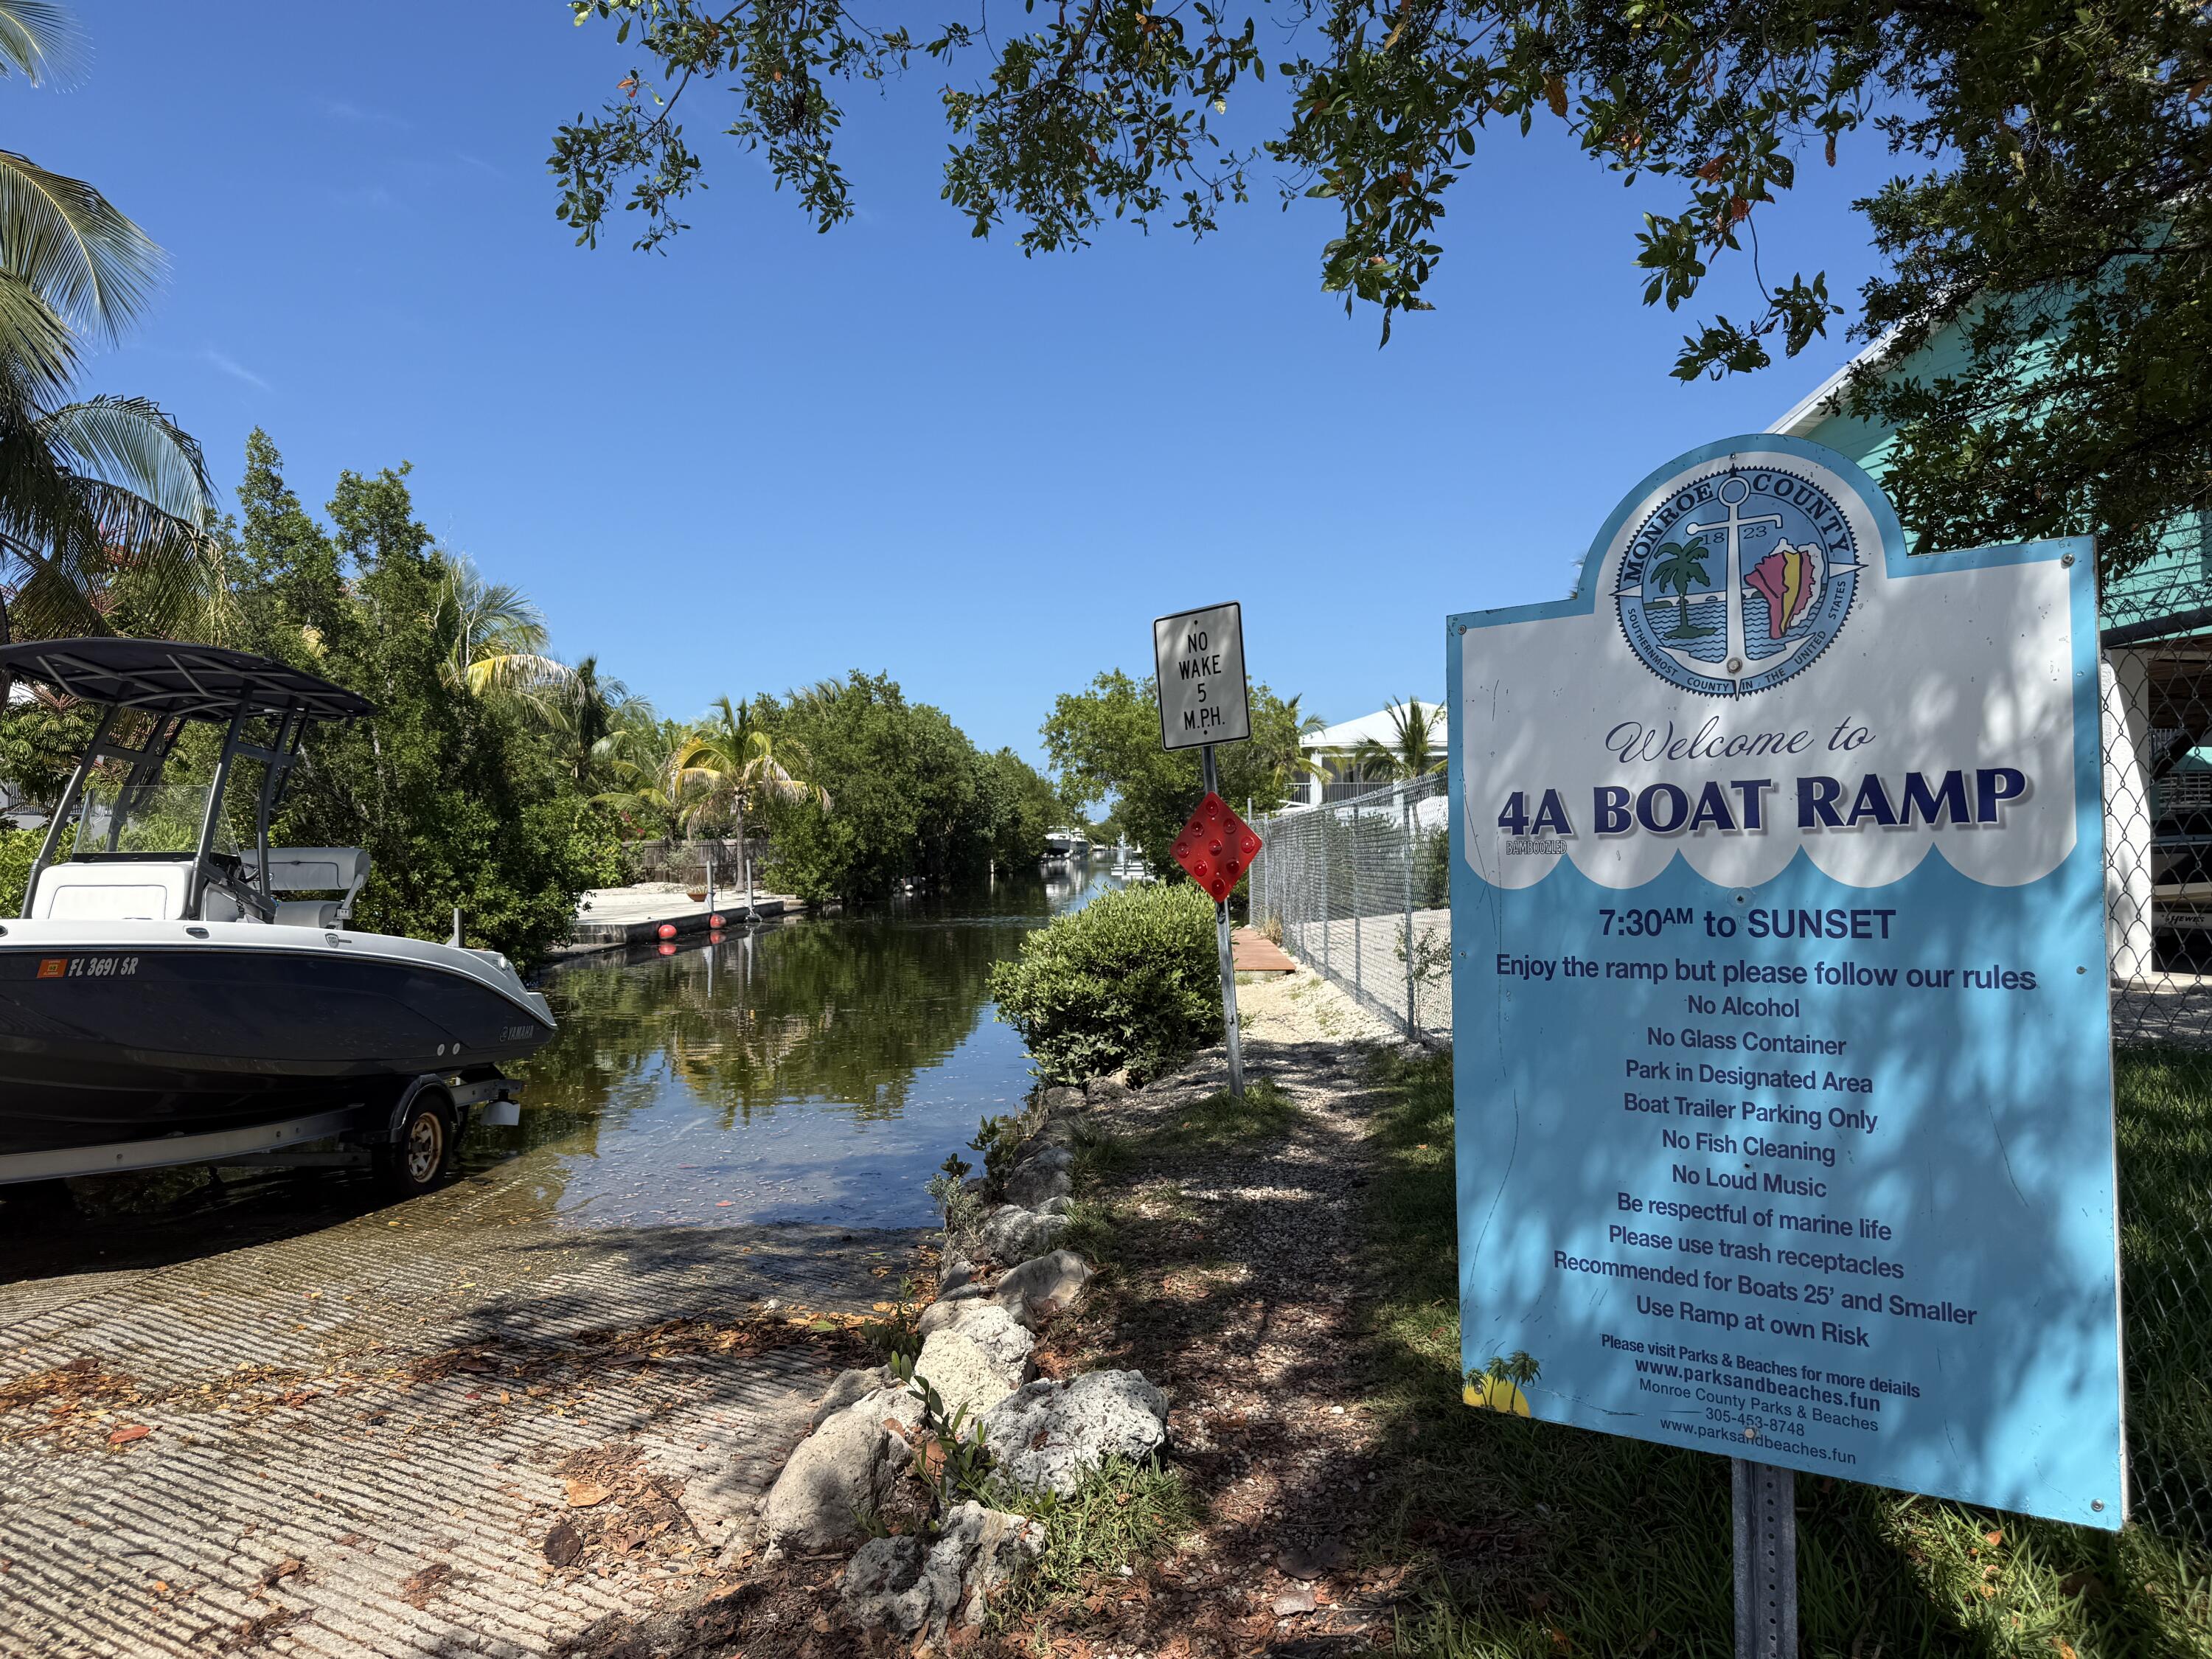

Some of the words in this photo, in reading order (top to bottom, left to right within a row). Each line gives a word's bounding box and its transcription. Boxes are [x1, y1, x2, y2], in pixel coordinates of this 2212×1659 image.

[1624, 483, 1713, 582] MONROE
[1753, 474, 1849, 553] COUNTY
[1703, 531, 1724, 545] 18
[1744, 526, 1767, 539] 23
[1188, 632, 1208, 653] NO
[1628, 608, 1677, 676] SOUTHERNMOST
[1687, 677, 1728, 692] COUNTY
[1742, 681, 1753, 690] IN
[1765, 668, 1786, 683] THE
[1795, 630, 1826, 665] UNITED
[1829, 581, 1846, 619] STATES
[1179, 655, 1221, 680] WAKE
[1197, 683, 1207, 703] 5
[1184, 706, 1225, 730] M.P.H.
[1605, 715, 1815, 765] Welcome
[1828, 716, 1876, 751] to
[1498, 789, 1572, 835] 4A
[1593, 779, 1773, 834] BOAT
[1797, 768, 2026, 828] RAMP
[1506, 840, 1567, 855] BAMBOOZLED
[1704, 911, 1736, 937] to
[1747, 909, 1896, 939] SUNSET
[69, 959, 85, 976] FL
[87, 958, 119, 976] 3691
[121, 957, 138, 975] SR
[1496, 954, 1557, 981] Enjoy
[1562, 956, 1600, 979] the
[1605, 961, 1667, 986] ramp
[1675, 959, 1716, 982] but
[1723, 960, 1807, 987] please
[1815, 961, 1901, 988] follow
[1907, 968, 1953, 990] our
[1963, 964, 2037, 991] rules
[1688, 995, 1715, 1015] No
[1722, 997, 1799, 1018] Alcohol
[1648, 1027, 1674, 1046] No
[1681, 1029, 1736, 1050] Glass
[1743, 1032, 1846, 1055] Container
[1626, 1060, 1669, 1080] Park
[1677, 1062, 1692, 1082] in
[1700, 1064, 1815, 1091] Designated
[1823, 1072, 1873, 1093] Area
[1624, 1093, 1669, 1113] Boat
[1674, 1096, 1736, 1119] Trailer
[1742, 1102, 1821, 1130] Parking
[1829, 1107, 1878, 1134] Only
[1663, 1130, 1690, 1150] No
[1696, 1133, 1736, 1155] Fish
[1744, 1137, 1835, 1167] Cleaning
[1672, 1164, 1700, 1184] No
[1706, 1168, 1757, 1191] Loud
[1764, 1174, 1826, 1198] Music
[1618, 1192, 1643, 1212] Be
[1649, 1198, 1747, 1225] respectful
[1753, 1208, 1773, 1227] of
[1779, 1214, 1852, 1236] marine
[1860, 1217, 1892, 1241] life
[1609, 1225, 1672, 1250] Please
[1678, 1236, 1714, 1254] use
[1719, 1238, 1770, 1262] trash
[1777, 1248, 1904, 1279] receptacles
[1554, 1251, 1698, 1288] Recommended
[1703, 1270, 1732, 1292] for
[1738, 1275, 1798, 1301] Boats
[1841, 1290, 1882, 1312] and
[1888, 1295, 1978, 1325] Smaller
[1636, 1295, 1674, 1318] Use
[1680, 1301, 1739, 1329] Ramp
[1745, 1312, 1764, 1332] at
[1770, 1319, 1815, 1339] own
[1821, 1321, 1869, 1347] Risk
[1601, 1334, 1644, 1353] Please
[1647, 1340, 1675, 1359] visit
[1679, 1346, 1718, 1366] Parks
[1722, 1352, 1733, 1367] &
[1736, 1354, 1797, 1378] Beaches
[1801, 1365, 1822, 1381] for
[1826, 1371, 1865, 1388] more
[1635, 1358, 1881, 1413] www.parksandbeaches.fun
[1640, 1378, 1691, 1399] Monroe
[1696, 1388, 1745, 1411] County
[1751, 1397, 1792, 1418] Parks
[1797, 1405, 1807, 1419] &
[1812, 1408, 1878, 1432] Beaches
[1705, 1407, 1805, 1437] 305-453-8748
